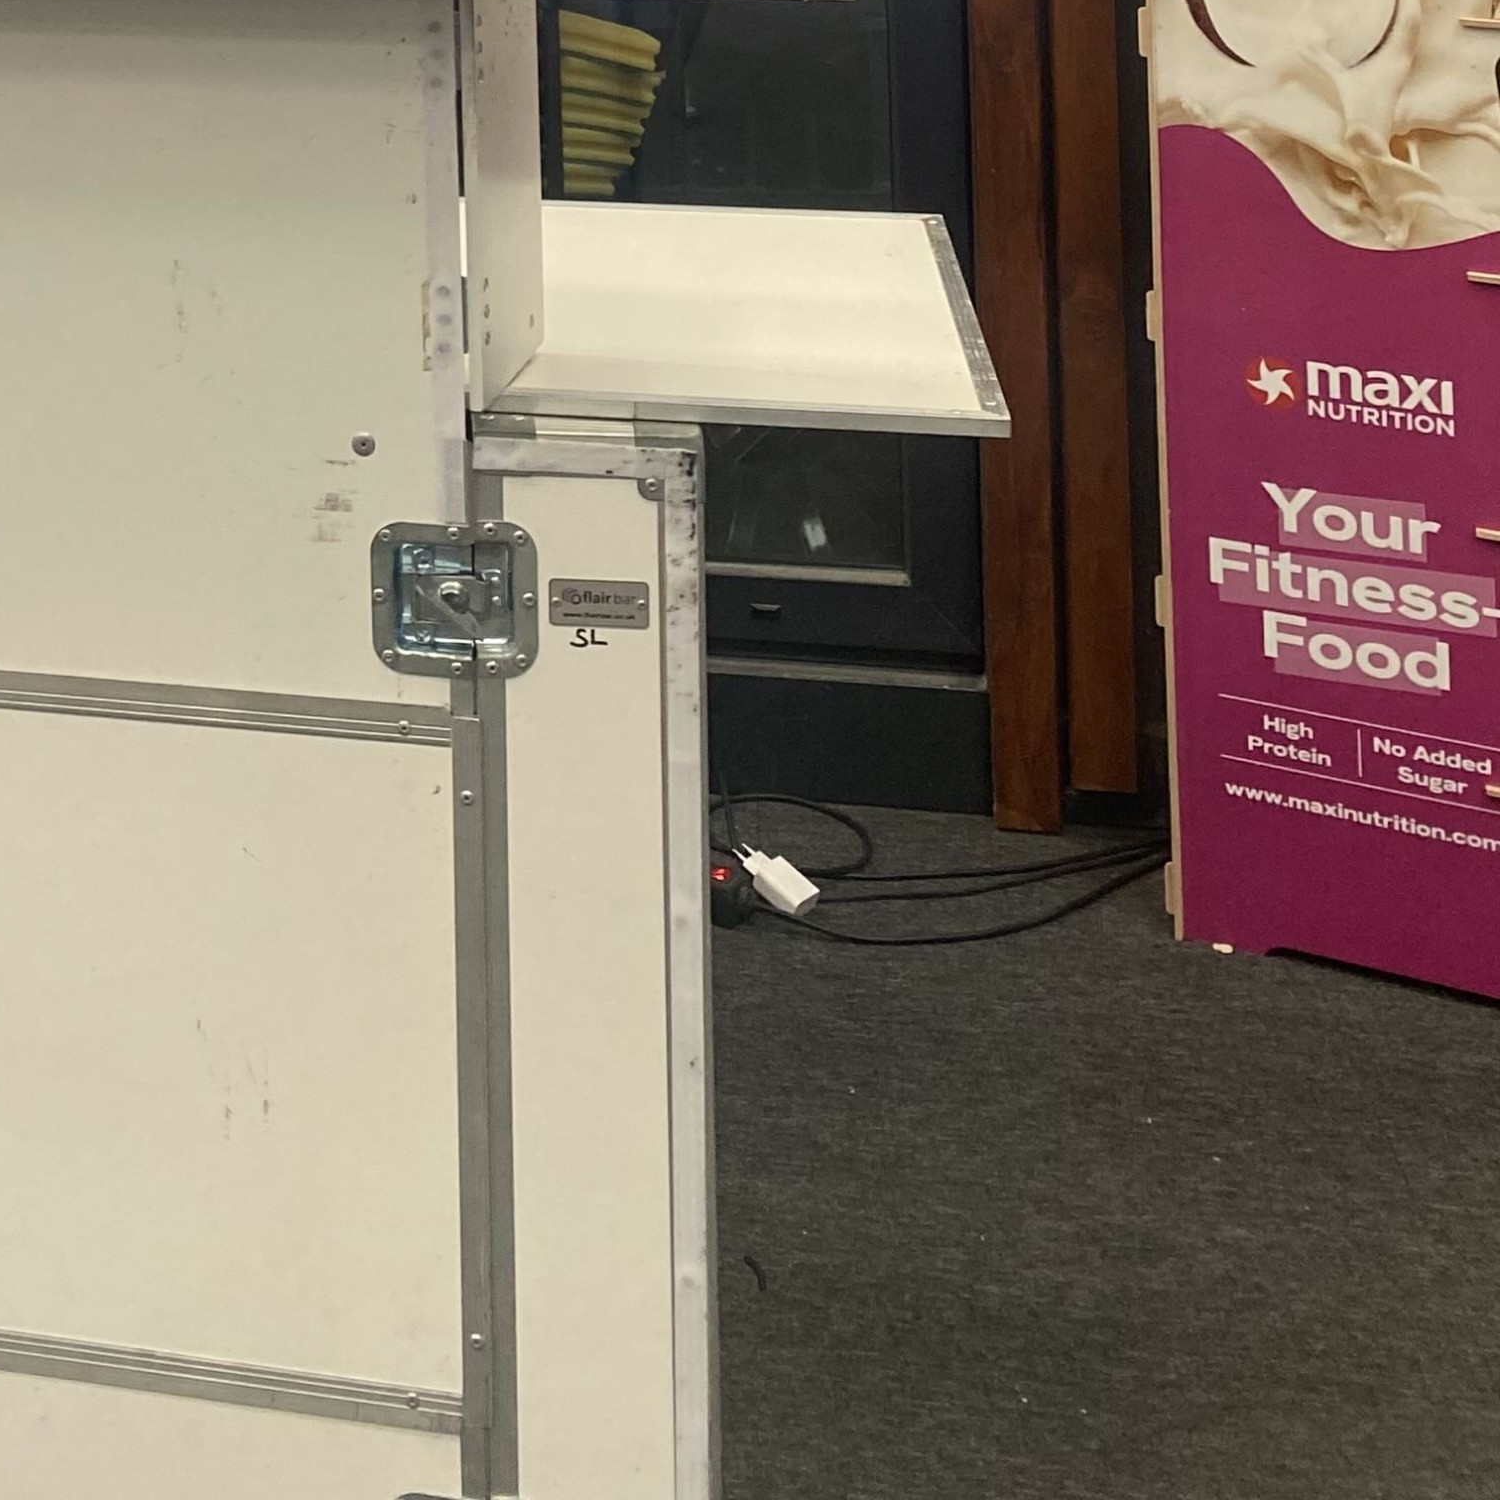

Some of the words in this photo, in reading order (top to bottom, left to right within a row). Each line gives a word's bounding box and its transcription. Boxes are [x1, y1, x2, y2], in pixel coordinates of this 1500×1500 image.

[1307, 398, 1456, 438] NUTRITION
[1261, 481, 1442, 555] Your
[1208, 536, 1500, 629] Fitness-
[569, 628, 609, 649] SL
[1262, 609, 1451, 692] Food
[1263, 713, 1314, 740] High
[1247, 734, 1332, 767] Protein
[1372, 736, 1407, 758] No
[1412, 744, 1493, 776] Added
[1397, 765, 1469, 795] Sugar
[1224, 781, 1500, 853] www.maxinutrition.com
